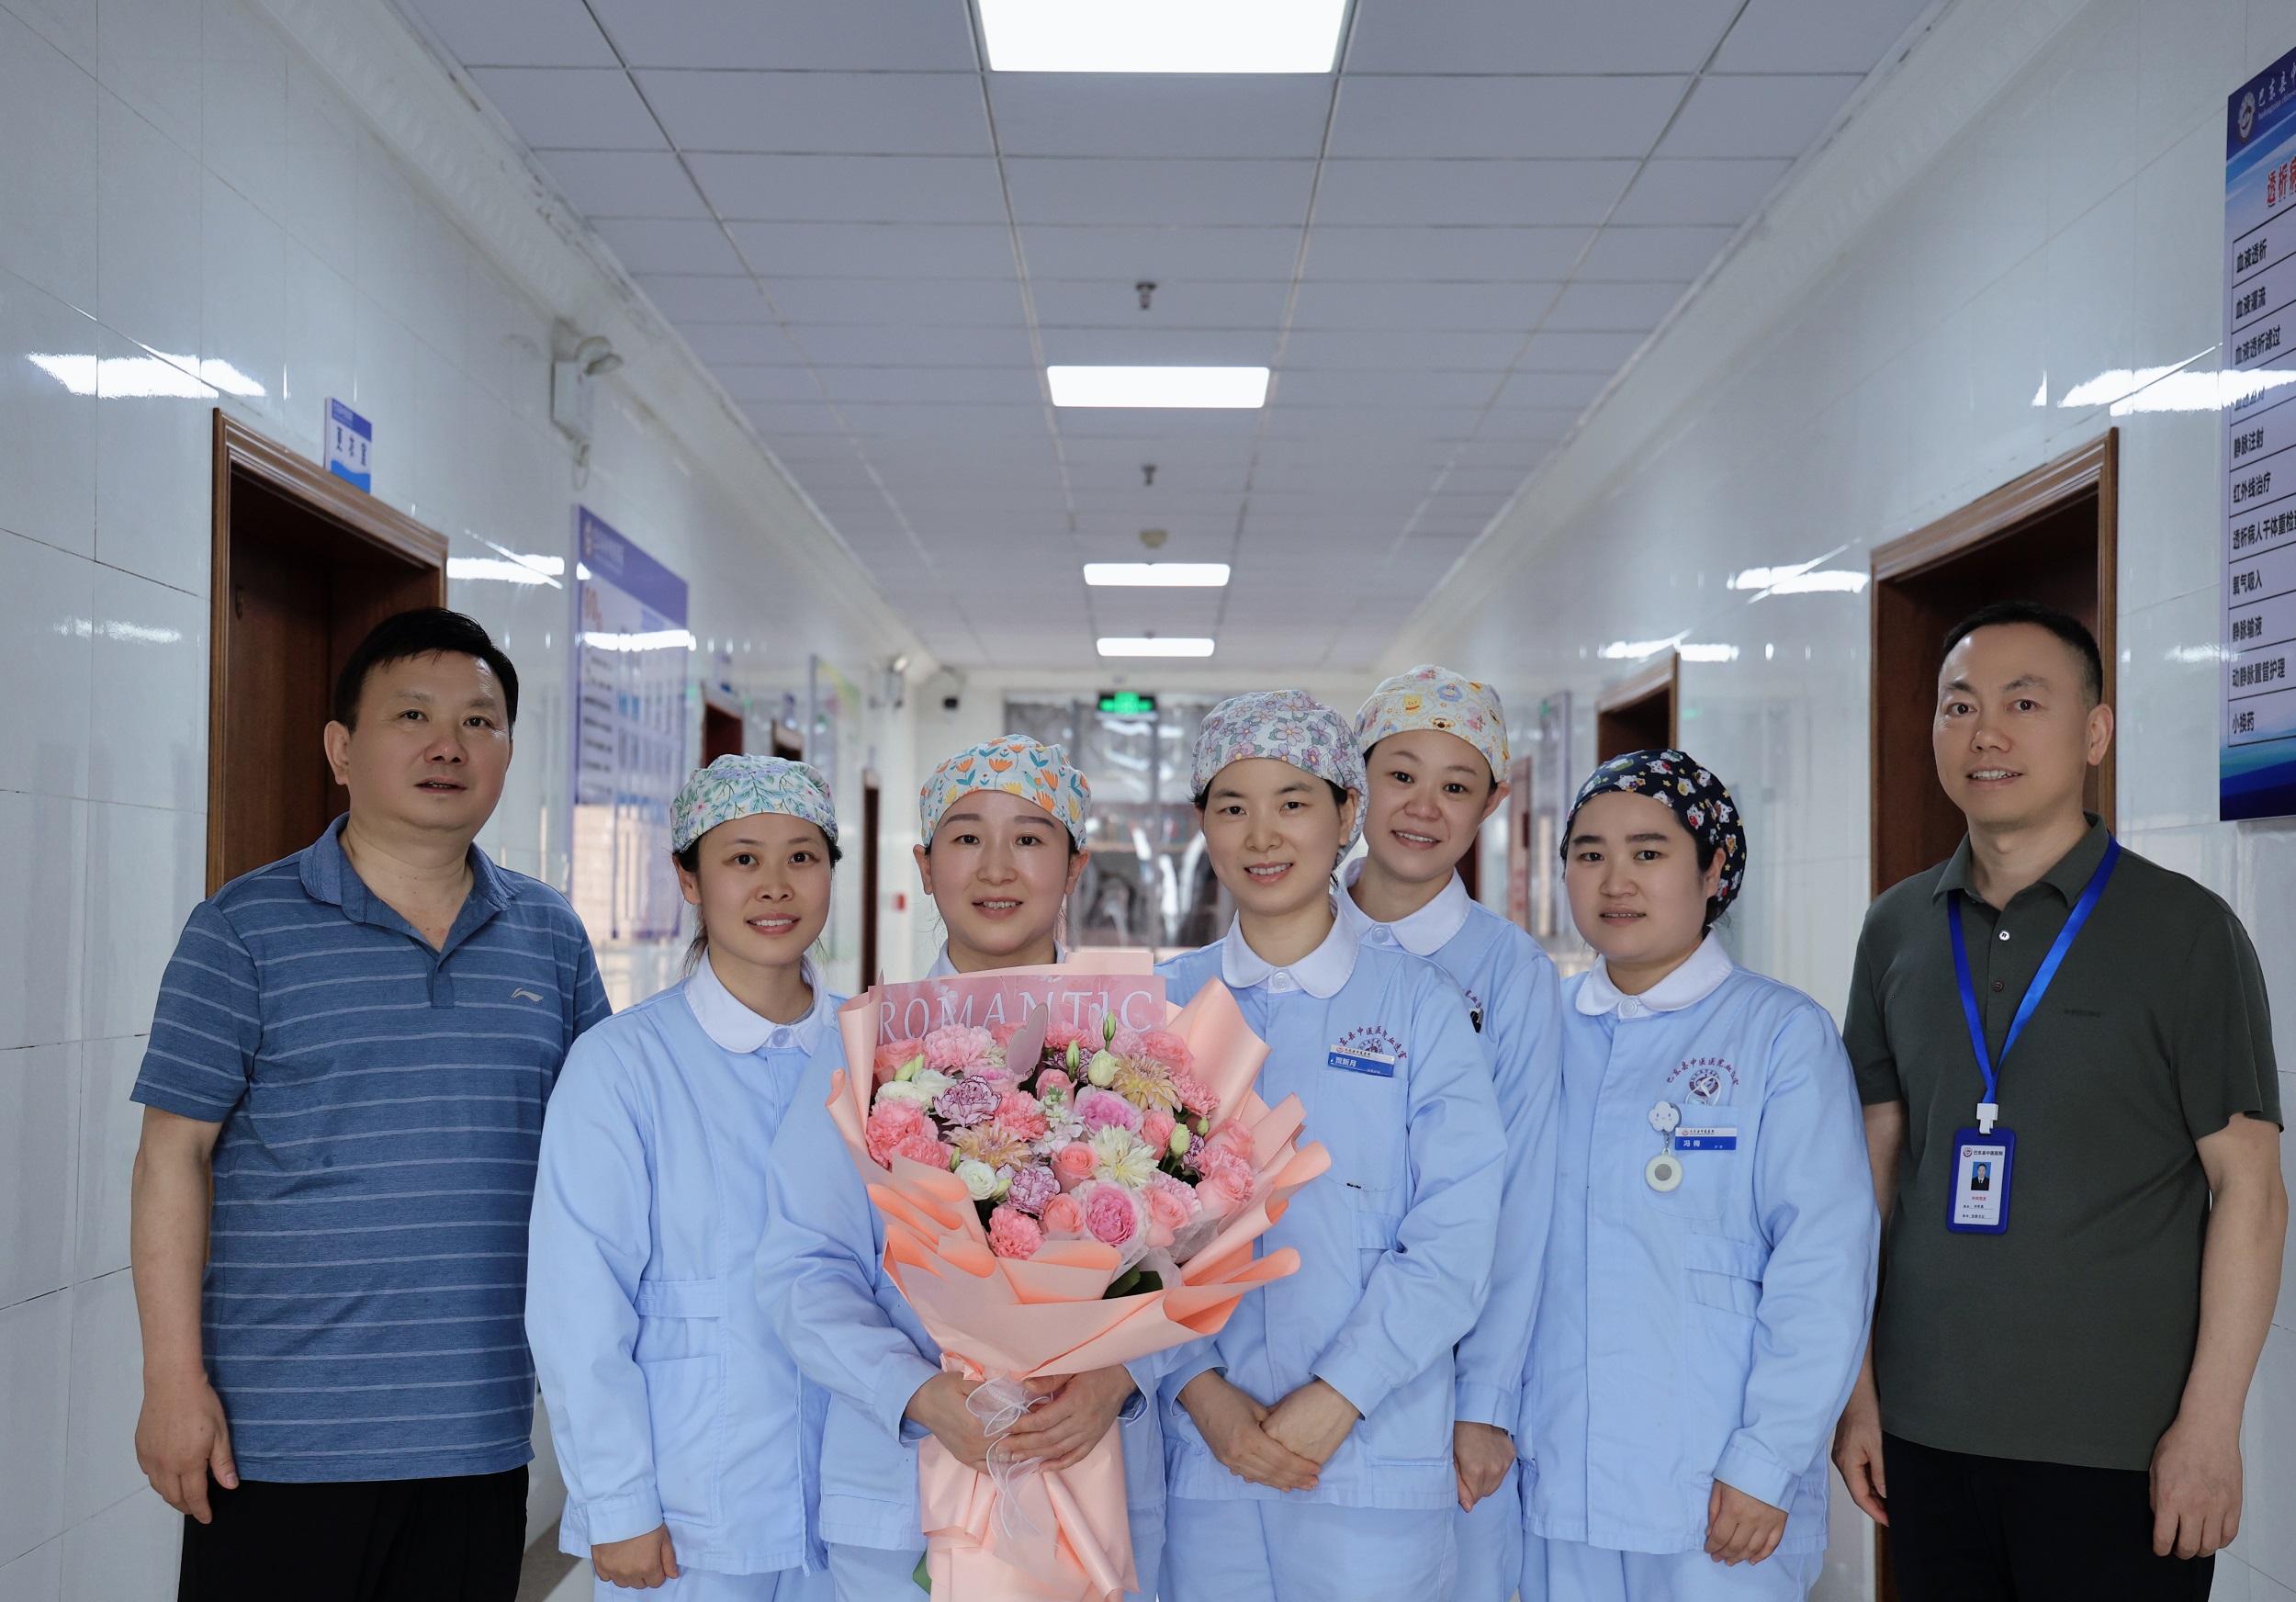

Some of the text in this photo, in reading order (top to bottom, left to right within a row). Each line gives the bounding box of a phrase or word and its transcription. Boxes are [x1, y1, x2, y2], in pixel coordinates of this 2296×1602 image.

[2236, 238, 2267, 273] 血液透析
[2235, 286, 2266, 320] 血液灌流
[2234, 324, 2280, 366] 血液透析滤过
[2234, 426, 2264, 458] 静脉注射
[2233, 471, 2271, 503] 红外线治疗
[2233, 511, 2296, 549] 透析病人干体重检
[2233, 569, 2262, 596] 氧气吸入
[2233, 615, 2262, 642] 静脉输液
[2232, 658, 2286, 687] 动静脉置管护理
[2232, 711, 2255, 734] 小换药
[879, 990, 1153, 1045] ROMANTIC
